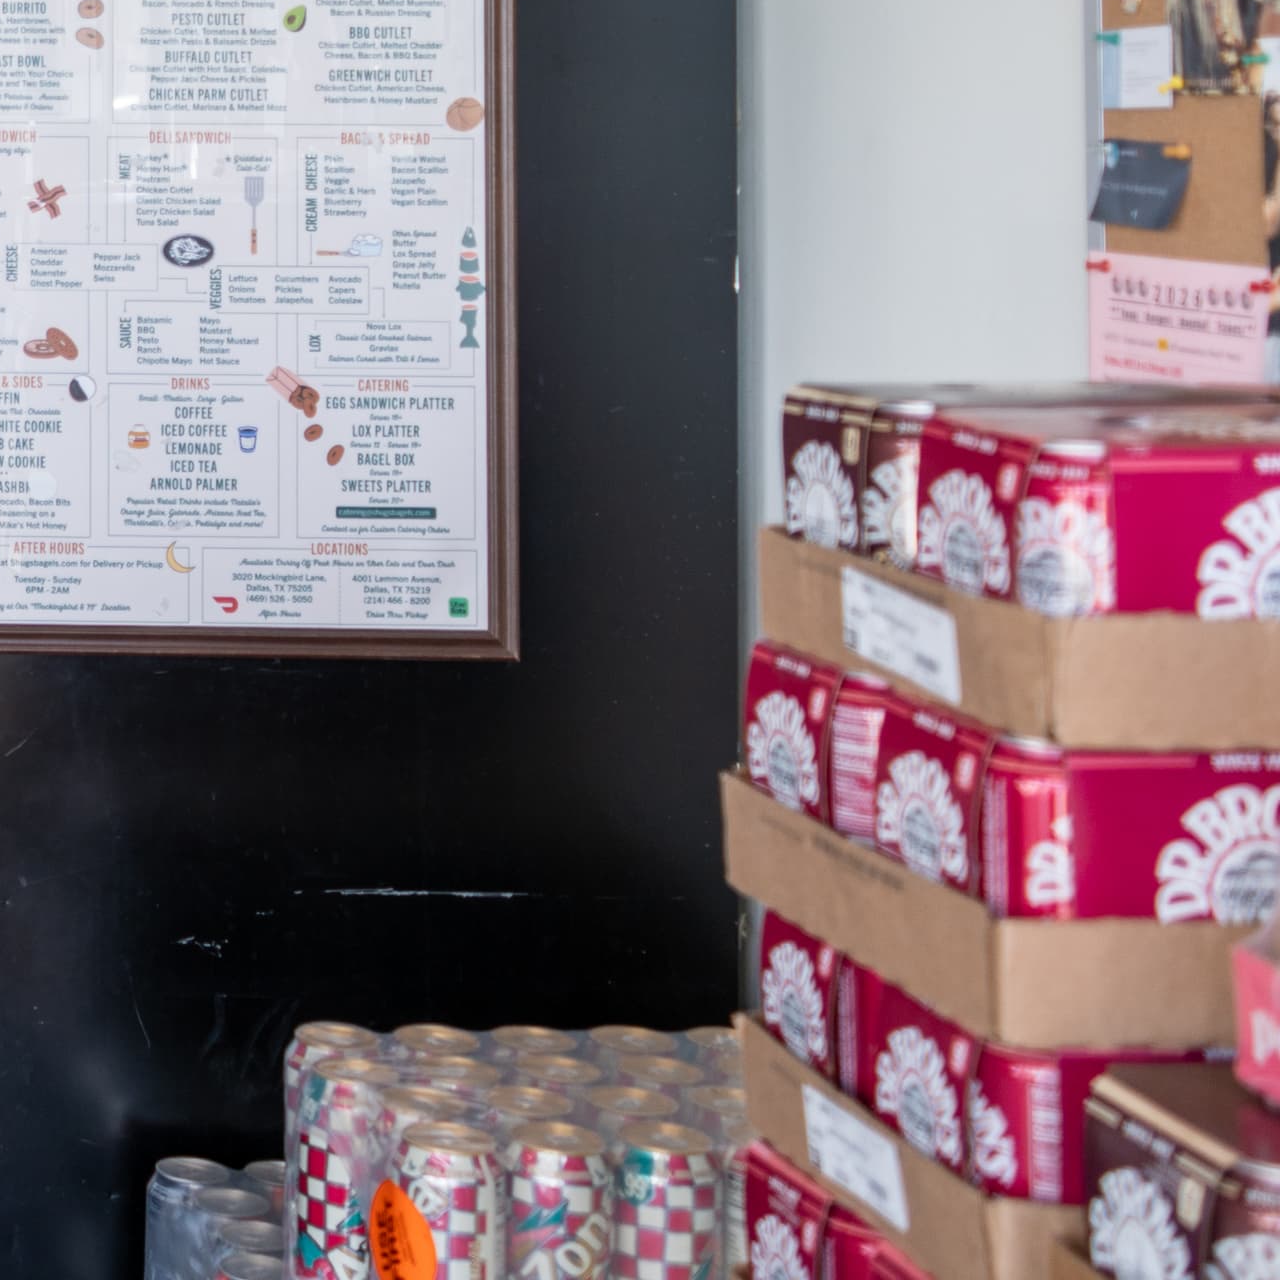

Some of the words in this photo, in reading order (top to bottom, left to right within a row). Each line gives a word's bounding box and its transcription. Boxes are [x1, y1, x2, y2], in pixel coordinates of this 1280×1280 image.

[329, 70, 390, 82] GREENWICH
[394, 70, 432, 82] CUTLET
[149, 88, 194, 101] CHICKEN
[198, 89, 226, 101] PARM
[230, 89, 269, 101] CUTLET
[209, 269, 222, 309] VEGGIES
[120, 317, 131, 348] SAUCE
[227, 337, 259, 345] Mustard
[2, 376, 8, 388] &
[13, 376, 43, 388] SIDES
[171, 378, 210, 390] DRINKS
[358, 379, 409, 391] CATERING
[165, 443, 222, 455] LEMONADE
[150, 478, 192, 490] ARNOLD
[196, 478, 238, 491] PALMER
[13, 542, 46, 554] AFTER
[50, 543, 84, 555] HOURS
[311, 544, 369, 555] LOCATIONS
[93, 560, 124, 569] Delivery
[136, 561, 163, 569] Pickup
[232, 574, 253, 582] 3020
